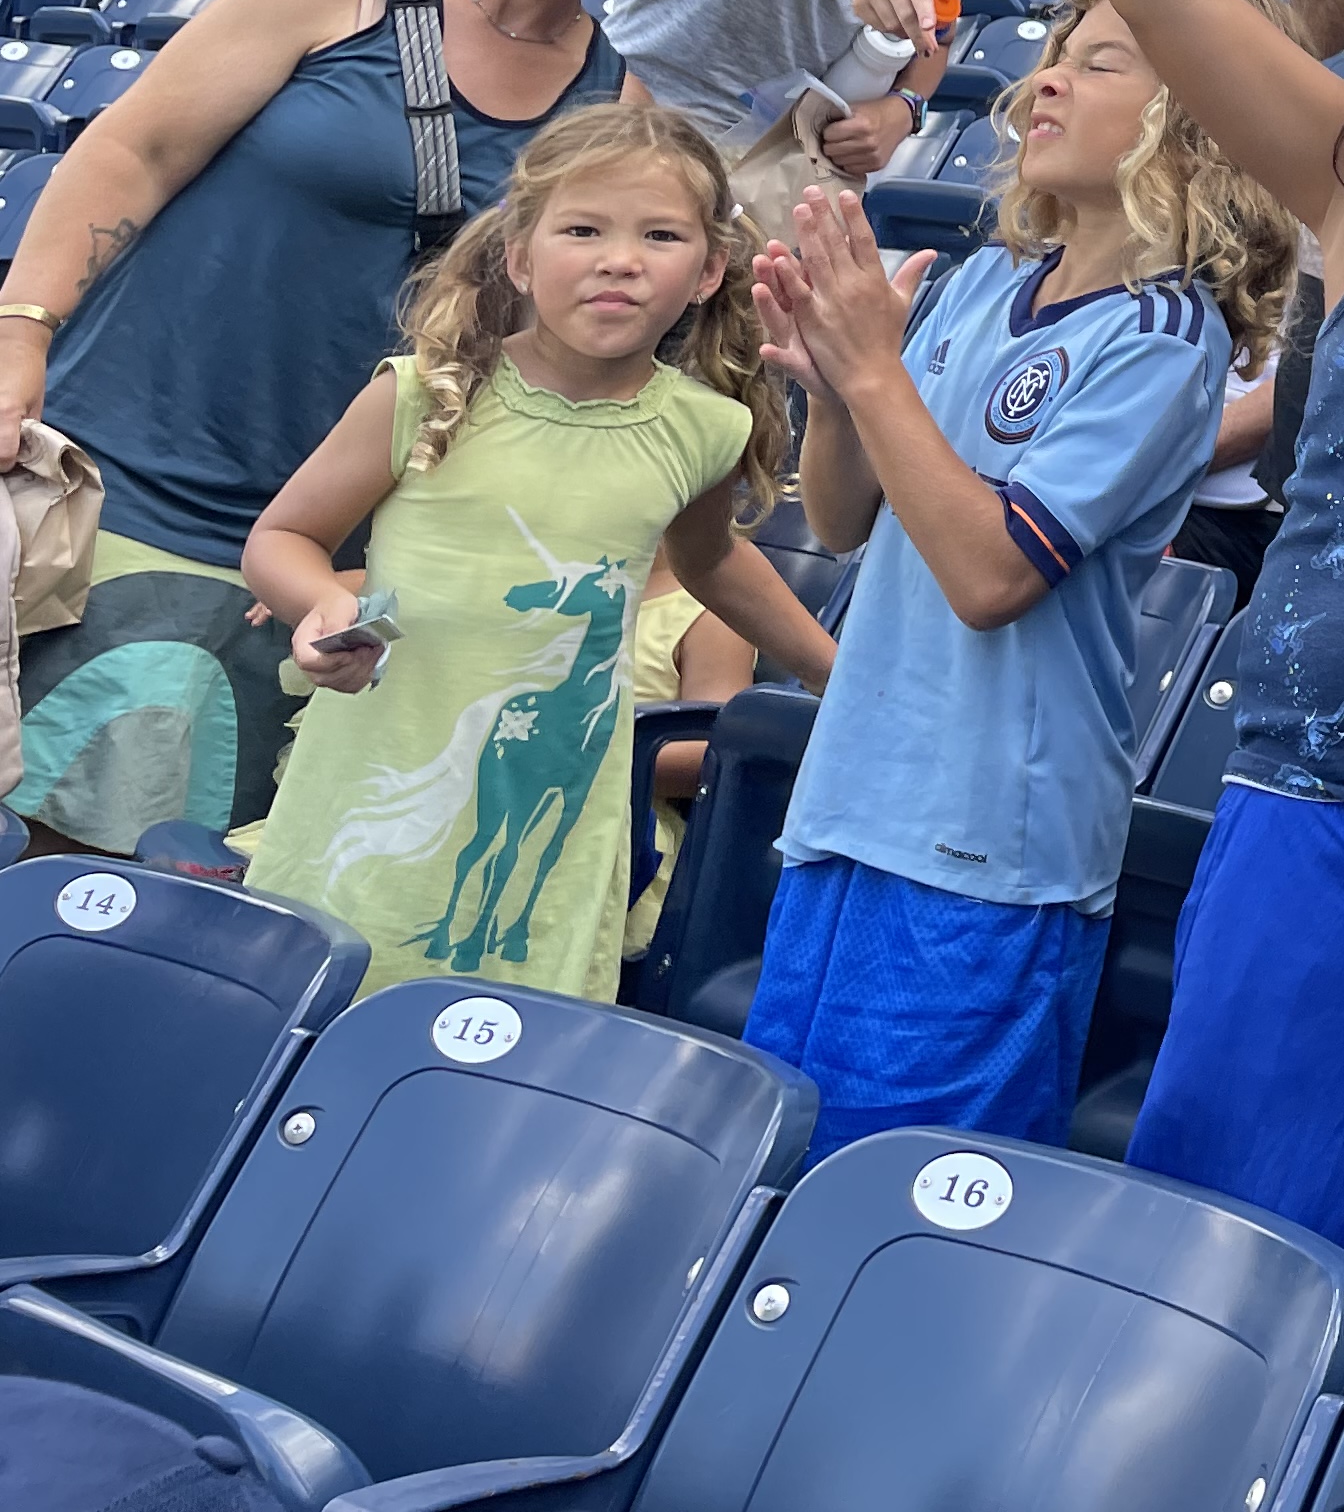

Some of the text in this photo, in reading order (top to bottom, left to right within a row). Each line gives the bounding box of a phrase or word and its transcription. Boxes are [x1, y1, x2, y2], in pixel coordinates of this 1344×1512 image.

[75, 888, 116, 916] 14
[452, 1016, 502, 1046] 15
[938, 1172, 991, 1209] 16
